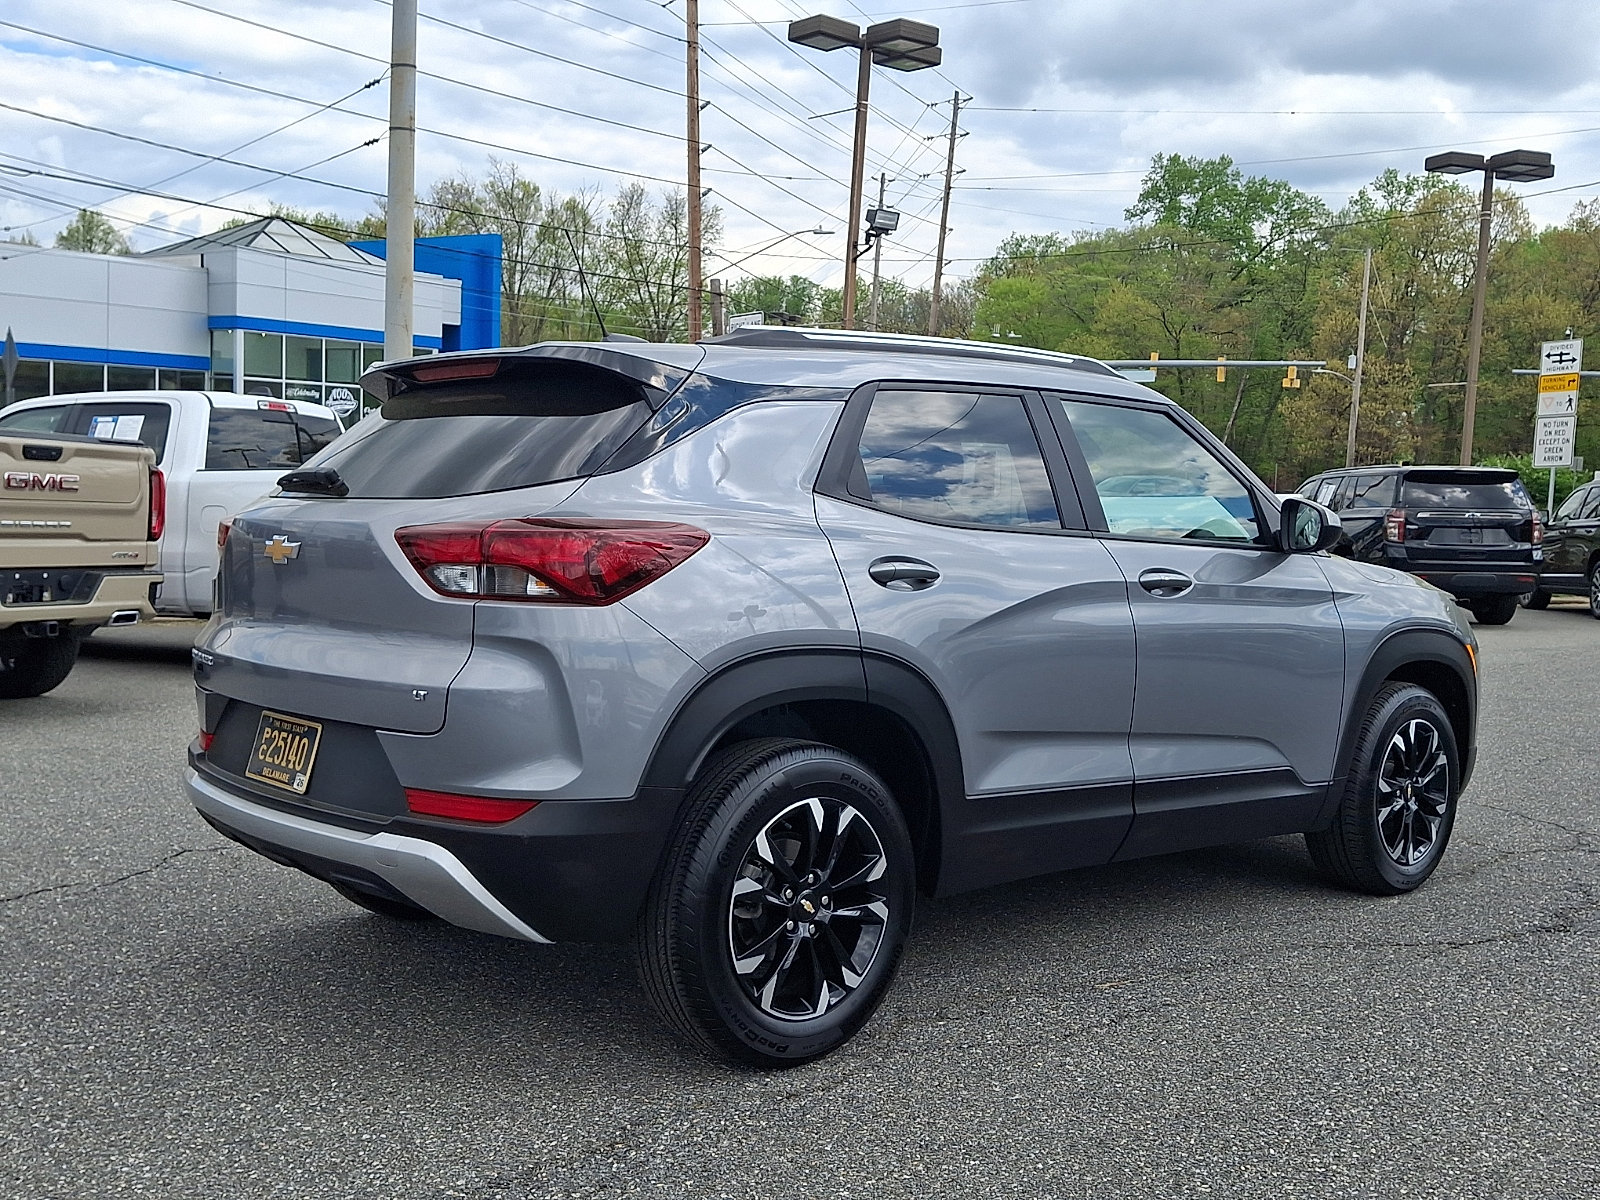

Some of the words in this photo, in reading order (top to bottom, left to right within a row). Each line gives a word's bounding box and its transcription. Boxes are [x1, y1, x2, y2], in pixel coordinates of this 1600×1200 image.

[1553, 420, 1569, 428] TURN
[1544, 429, 1553, 437] ON
[1543, 446, 1564, 454] GREEN
[4, 471, 80, 493] GMC
[412, 690, 428, 701] LT
[262, 767, 290, 783] DELAWARE
